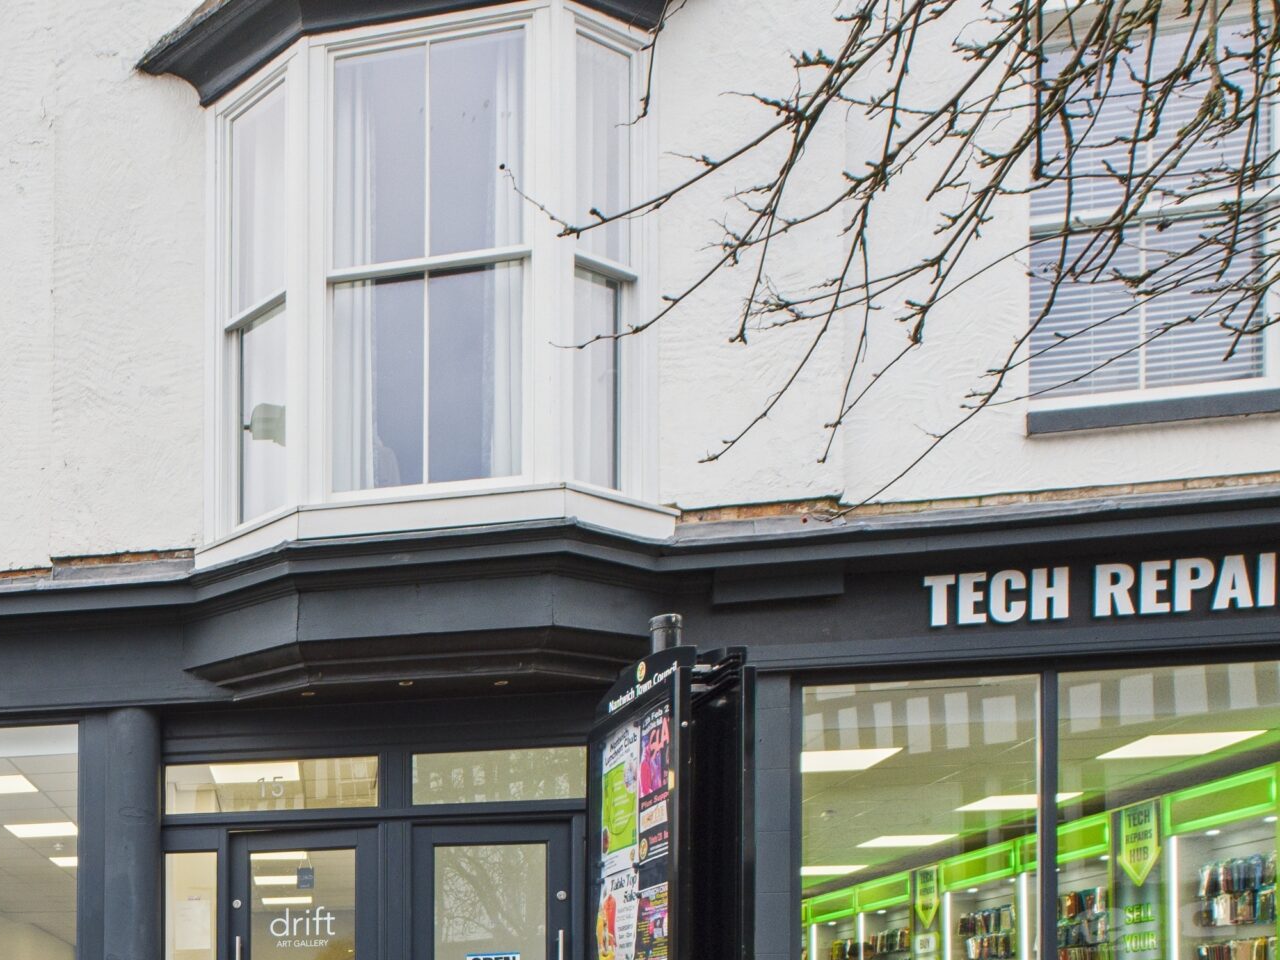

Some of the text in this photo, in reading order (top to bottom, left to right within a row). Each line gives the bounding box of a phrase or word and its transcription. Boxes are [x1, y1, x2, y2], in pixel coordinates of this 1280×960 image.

[923, 552, 1277, 627] TECH REPAI
[608, 660, 678, 713] Nantwich Town Council
[624, 733, 637, 748] Club
[257, 776, 284, 798] 15
[1126, 808, 1151, 828] TECH
[1125, 828, 1153, 844] REPAIRS
[1129, 846, 1149, 863] HUB
[611, 873, 637, 892] Table Top
[270, 906, 336, 937] drift
[1124, 902, 1155, 924] SELL
[276, 939, 329, 948] ART GALLERY
[919, 937, 930, 949] BUY
[1122, 931, 1158, 953] YOUR
